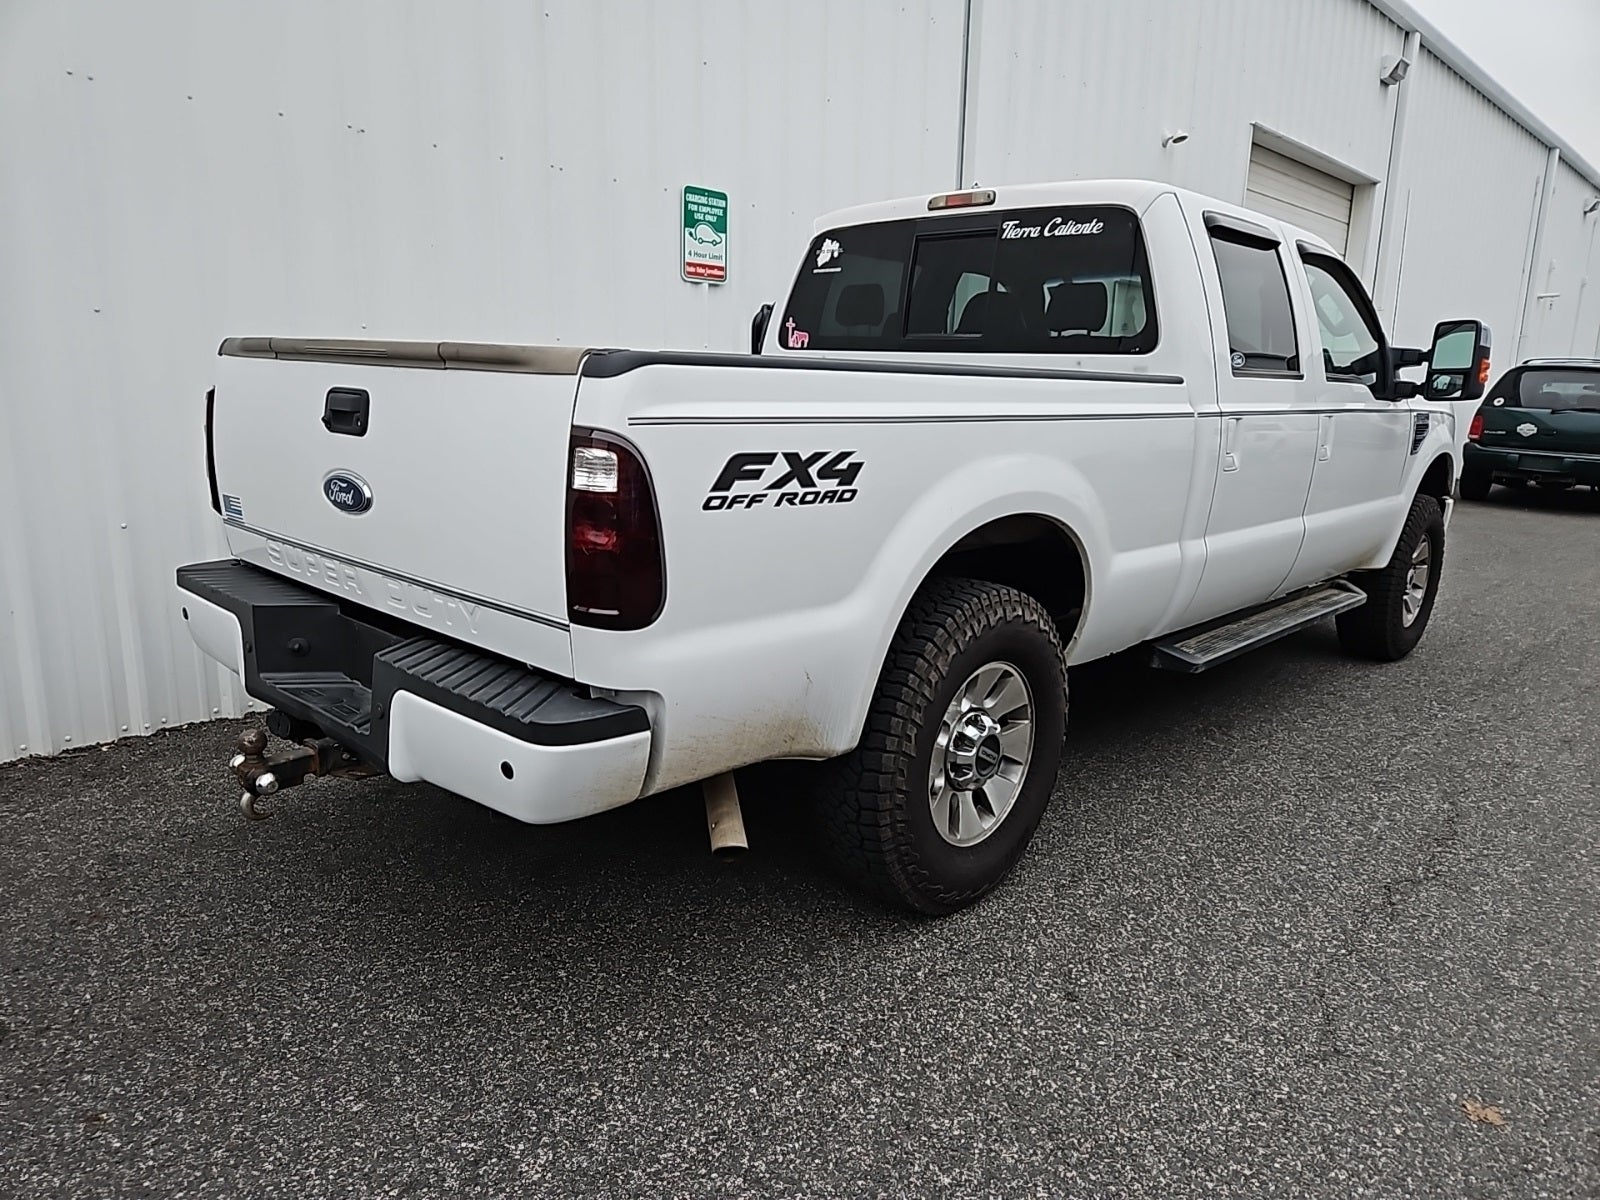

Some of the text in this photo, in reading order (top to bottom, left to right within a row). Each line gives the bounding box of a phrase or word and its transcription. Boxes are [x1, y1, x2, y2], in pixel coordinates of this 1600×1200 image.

[688, 203, 723, 216] FOR EMPLOYEE
[694, 211, 717, 222] USE ONLY
[1001, 217, 1104, 239] Tierra Caliente
[693, 250, 707, 259] Hour
[708, 252, 723, 261] Limit
[709, 451, 865, 492] FX4
[329, 479, 354, 505] Ford
[702, 489, 858, 511] OFF ROAD
[266, 539, 481, 634] SUPER DUTY
